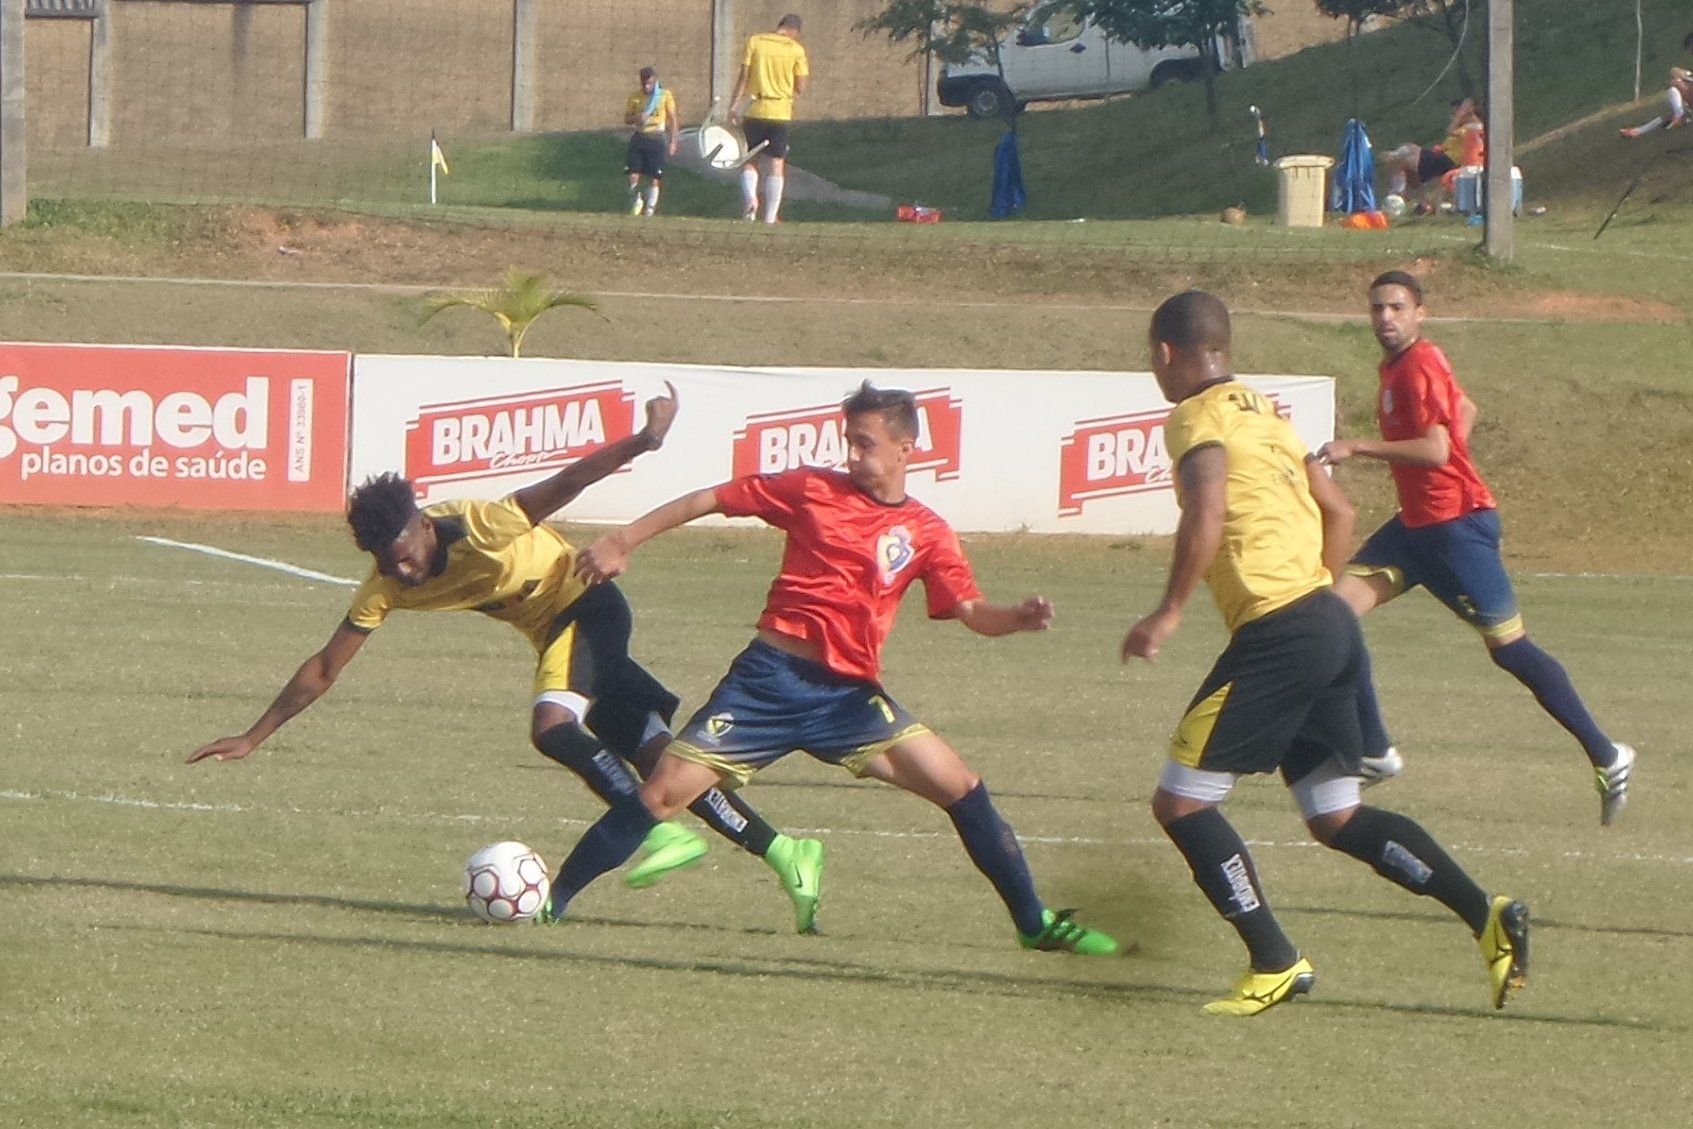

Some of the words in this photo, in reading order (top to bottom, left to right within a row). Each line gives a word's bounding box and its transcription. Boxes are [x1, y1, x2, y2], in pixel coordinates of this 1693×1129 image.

[21, 446, 123, 480] planos
[129, 448, 168, 477] de
[175, 451, 267, 480] saúde
[431, 398, 606, 466] BRAHMA
[760, 407, 933, 474] BRAA
[1086, 424, 1174, 482] BRA
